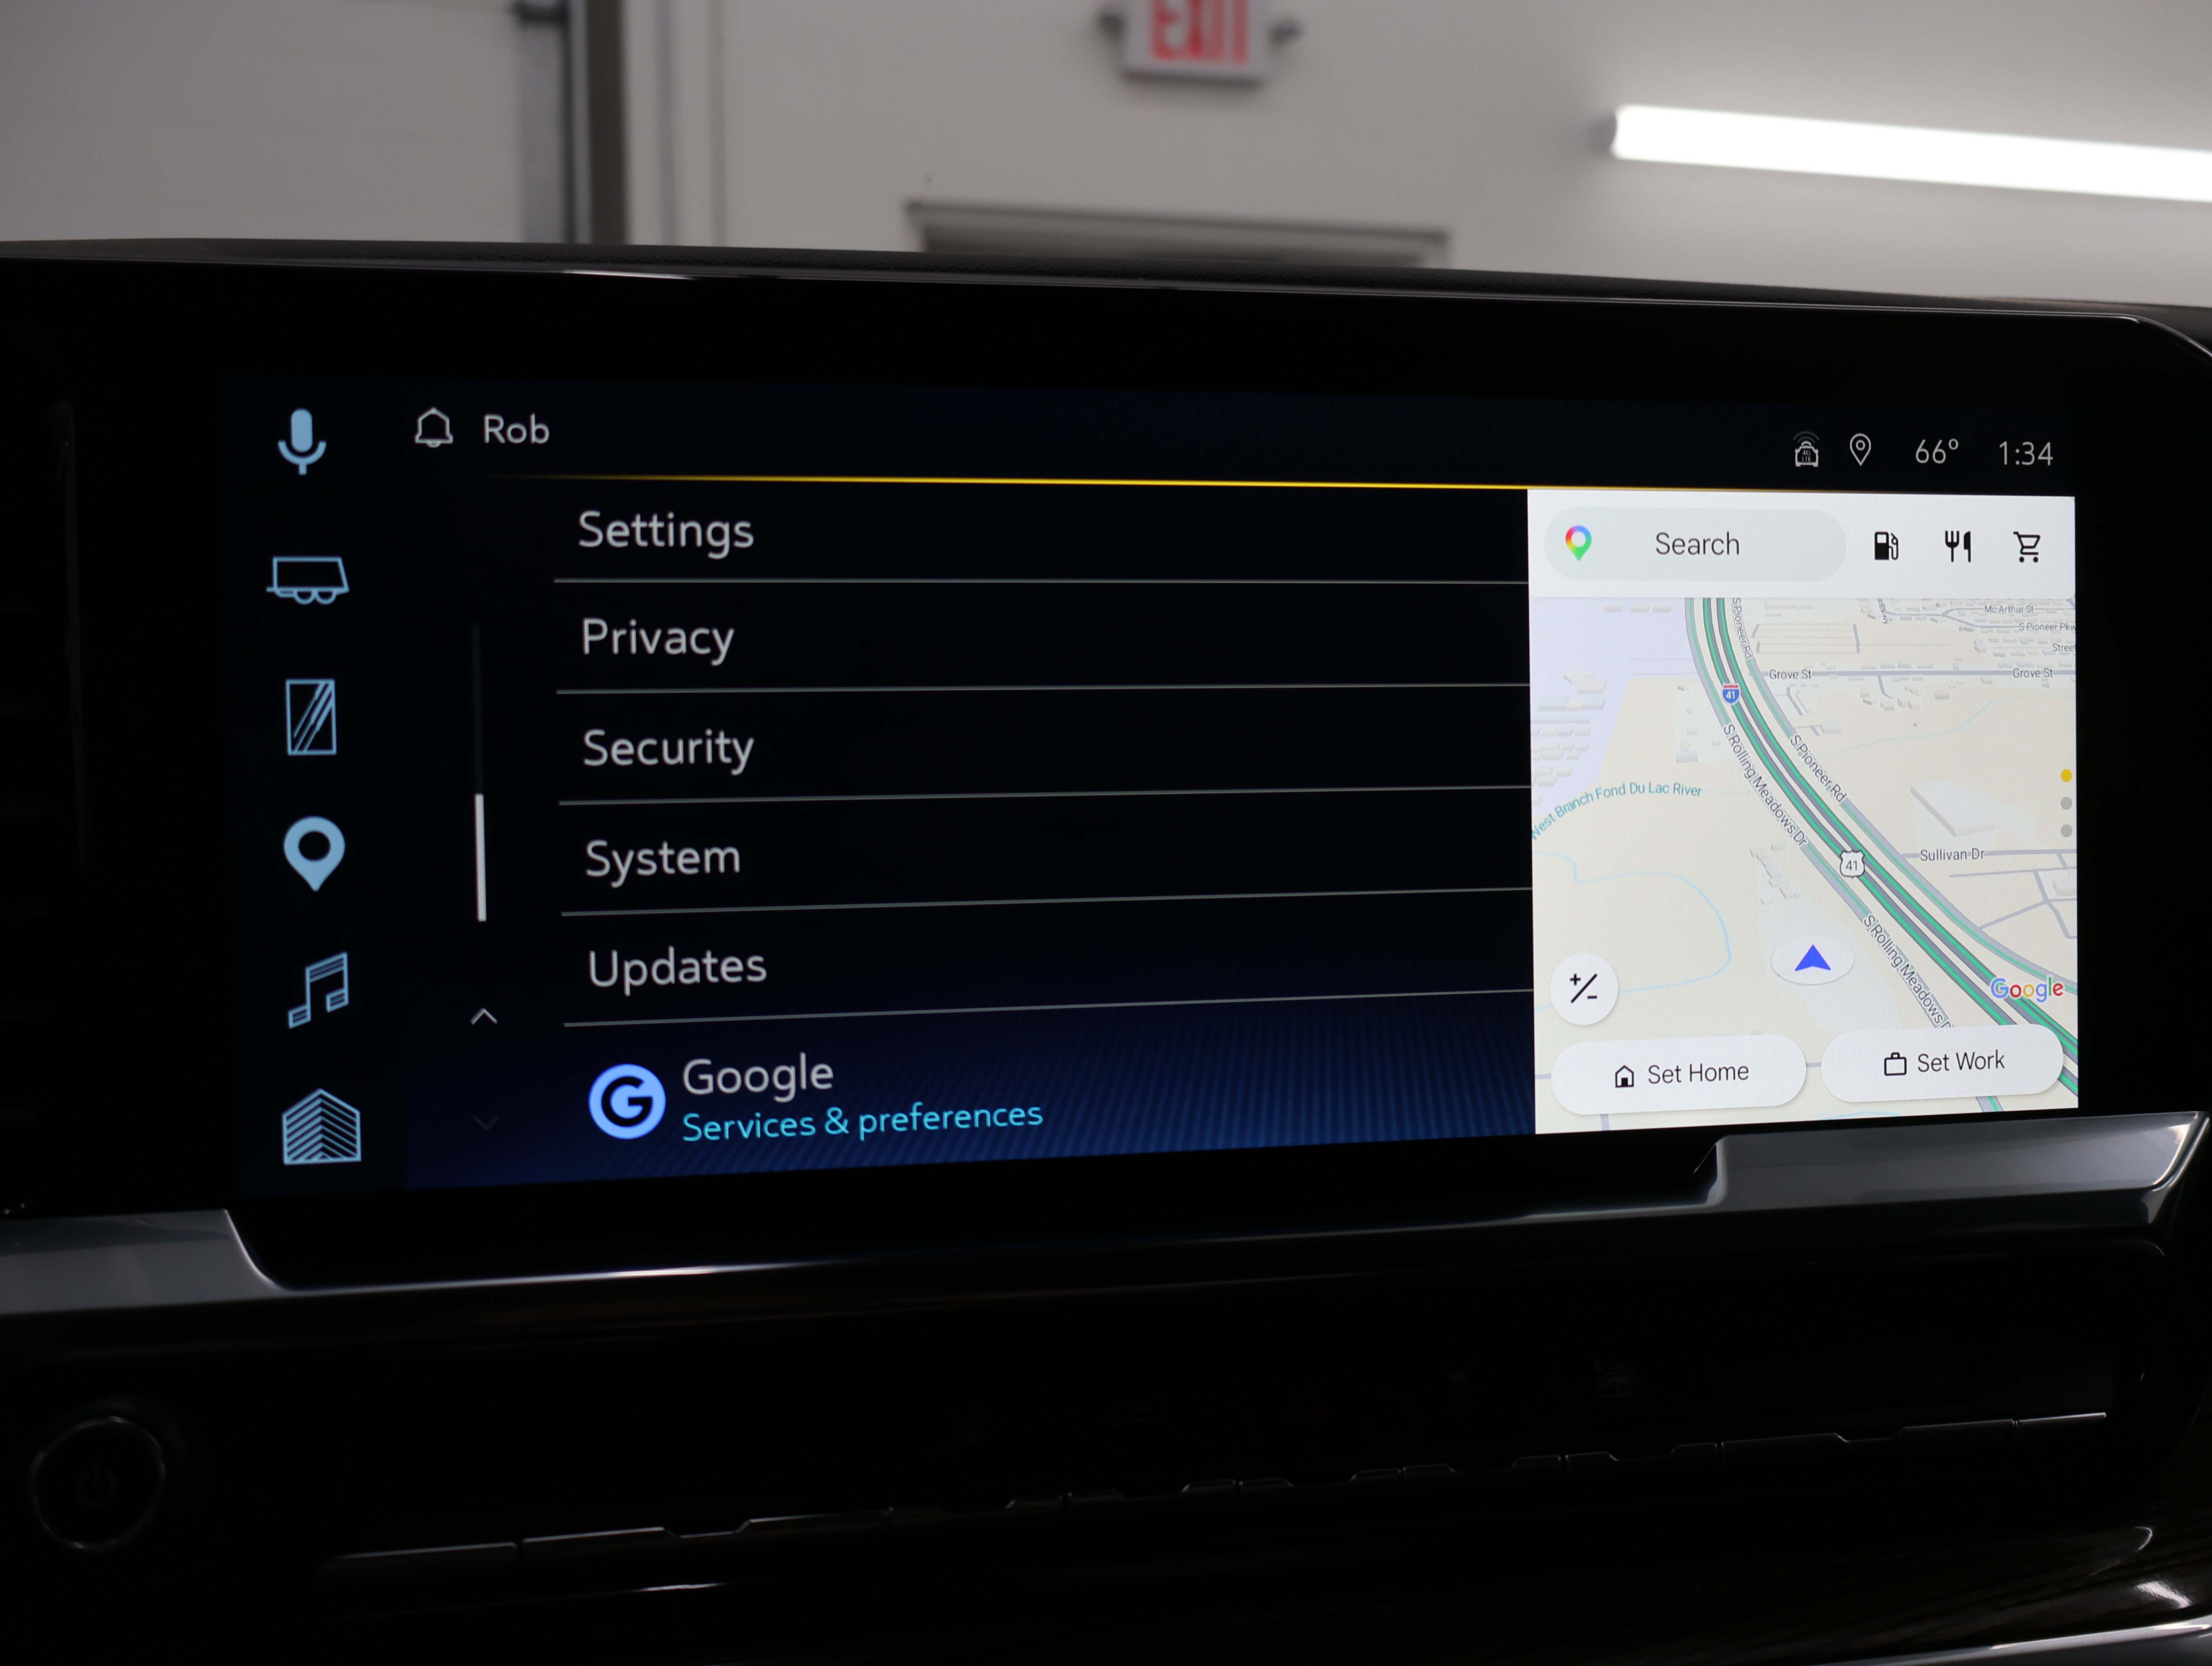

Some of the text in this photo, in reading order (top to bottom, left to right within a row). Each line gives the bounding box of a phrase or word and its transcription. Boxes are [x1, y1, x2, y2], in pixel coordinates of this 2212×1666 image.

[484, 413, 550, 444] Rob
[1999, 441, 2053, 466] 1:34
[579, 510, 754, 560] Settings
[1656, 531, 1739, 555] Search
[583, 618, 734, 666] Privacy
[1733, 606, 1746, 644] Pioneer
[1742, 645, 1753, 659] Rd
[2019, 623, 2025, 631] S
[2052, 643, 2075, 652] Stree
[1770, 669, 1812, 679] Grove St
[2013, 668, 2053, 678] Grove St
[1726, 690, 1735, 700] 41
[584, 728, 754, 776] Security
[1790, 735, 1847, 803] S Pioneer Rd
[1554, 791, 1594, 817] Branch
[1596, 783, 1626, 800] Fond
[1630, 782, 1645, 794] Du
[1649, 782, 1669, 794] Lac
[1673, 783, 1702, 797] River
[1724, 724, 1807, 846] S Rolling Meadows Dr
[587, 840, 740, 888] System
[1845, 860, 1857, 871] 41
[1920, 848, 1985, 861] Sullivan Dr
[589, 946, 767, 996] Updates
[1864, 915, 1943, 1024] S Rolling Meadows
[1991, 977, 2064, 1003] Google
[1648, 1063, 1749, 1084] Set Home
[1918, 1049, 2005, 1072] Set Work
[683, 1052, 834, 1102] Google
[683, 1101, 1044, 1142] Services & preferences
